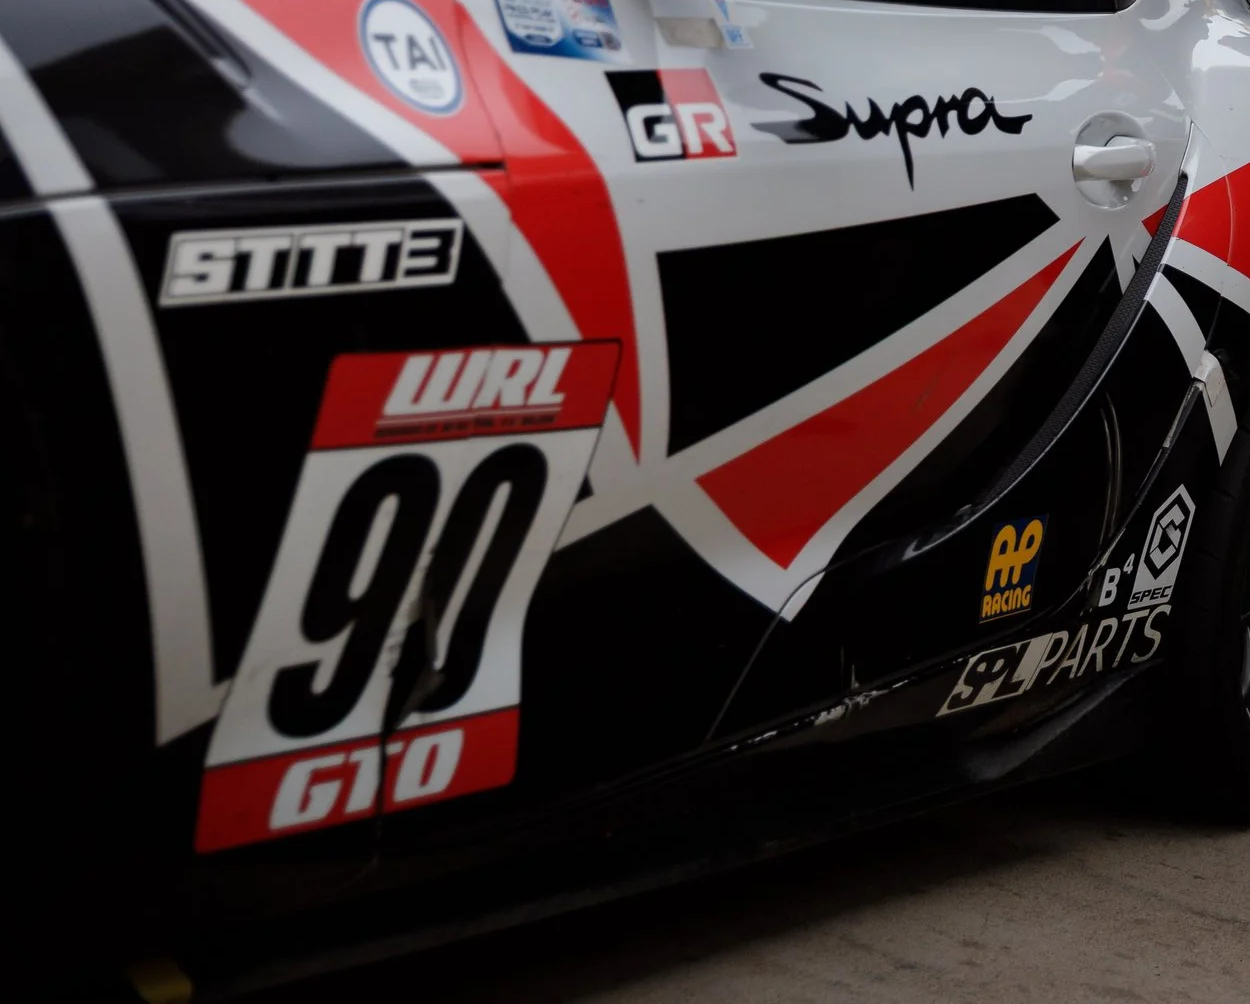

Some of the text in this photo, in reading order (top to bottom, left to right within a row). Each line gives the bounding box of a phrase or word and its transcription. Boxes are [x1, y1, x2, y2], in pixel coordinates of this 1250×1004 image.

[373, 33, 447, 71] TAI
[626, 103, 735, 158] GR
[749, 72, 1034, 192] Supra
[380, 347, 574, 417] WRL
[266, 442, 549, 739] 90
[982, 584, 1032, 618] RACING
[1129, 585, 1173, 605] SPEC
[1025, 604, 1172, 691] PARTS
[269, 728, 465, 832] GTO
